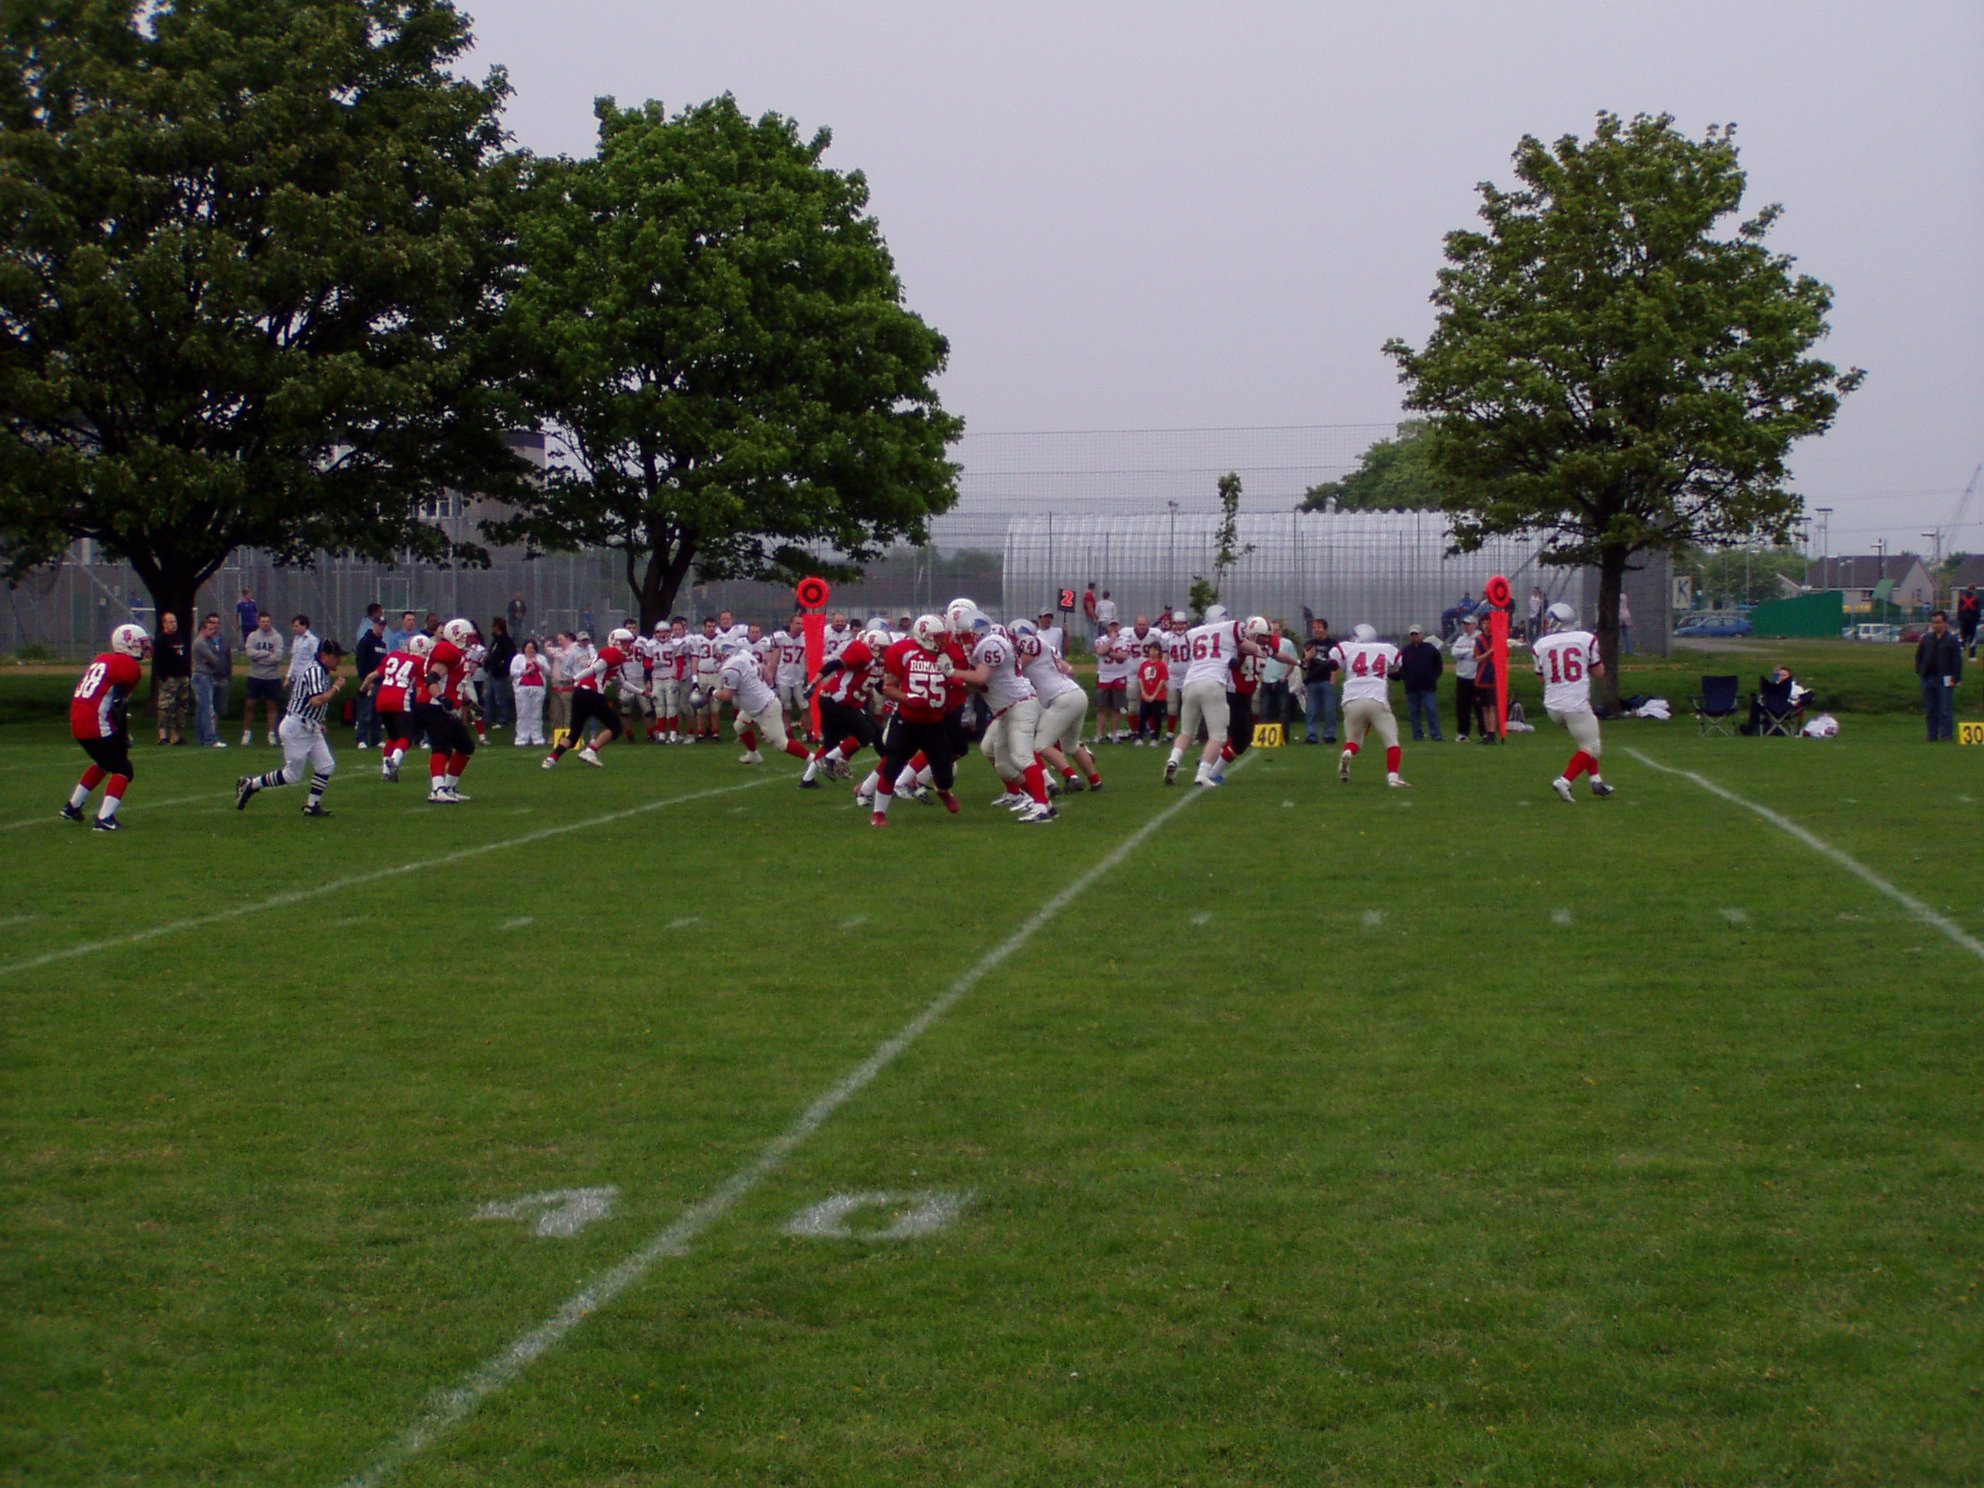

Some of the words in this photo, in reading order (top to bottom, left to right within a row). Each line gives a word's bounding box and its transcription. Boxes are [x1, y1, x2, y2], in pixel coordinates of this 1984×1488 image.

[1061, 590, 1074, 607] 2
[782, 645, 805, 664] 57
[1170, 644, 1190, 662] 40
[1193, 632, 1222, 660] 61
[656, 651, 673, 667] 15
[984, 650, 1001, 663] 65
[1352, 652, 1387, 678] 44
[1548, 647, 1582, 683] 16
[382, 656, 414, 688] 24
[910, 660, 941, 673] ROMA
[907, 672, 946, 708] 55
[1258, 727, 1277, 745] 40
[1963, 725, 1983, 744] 30
